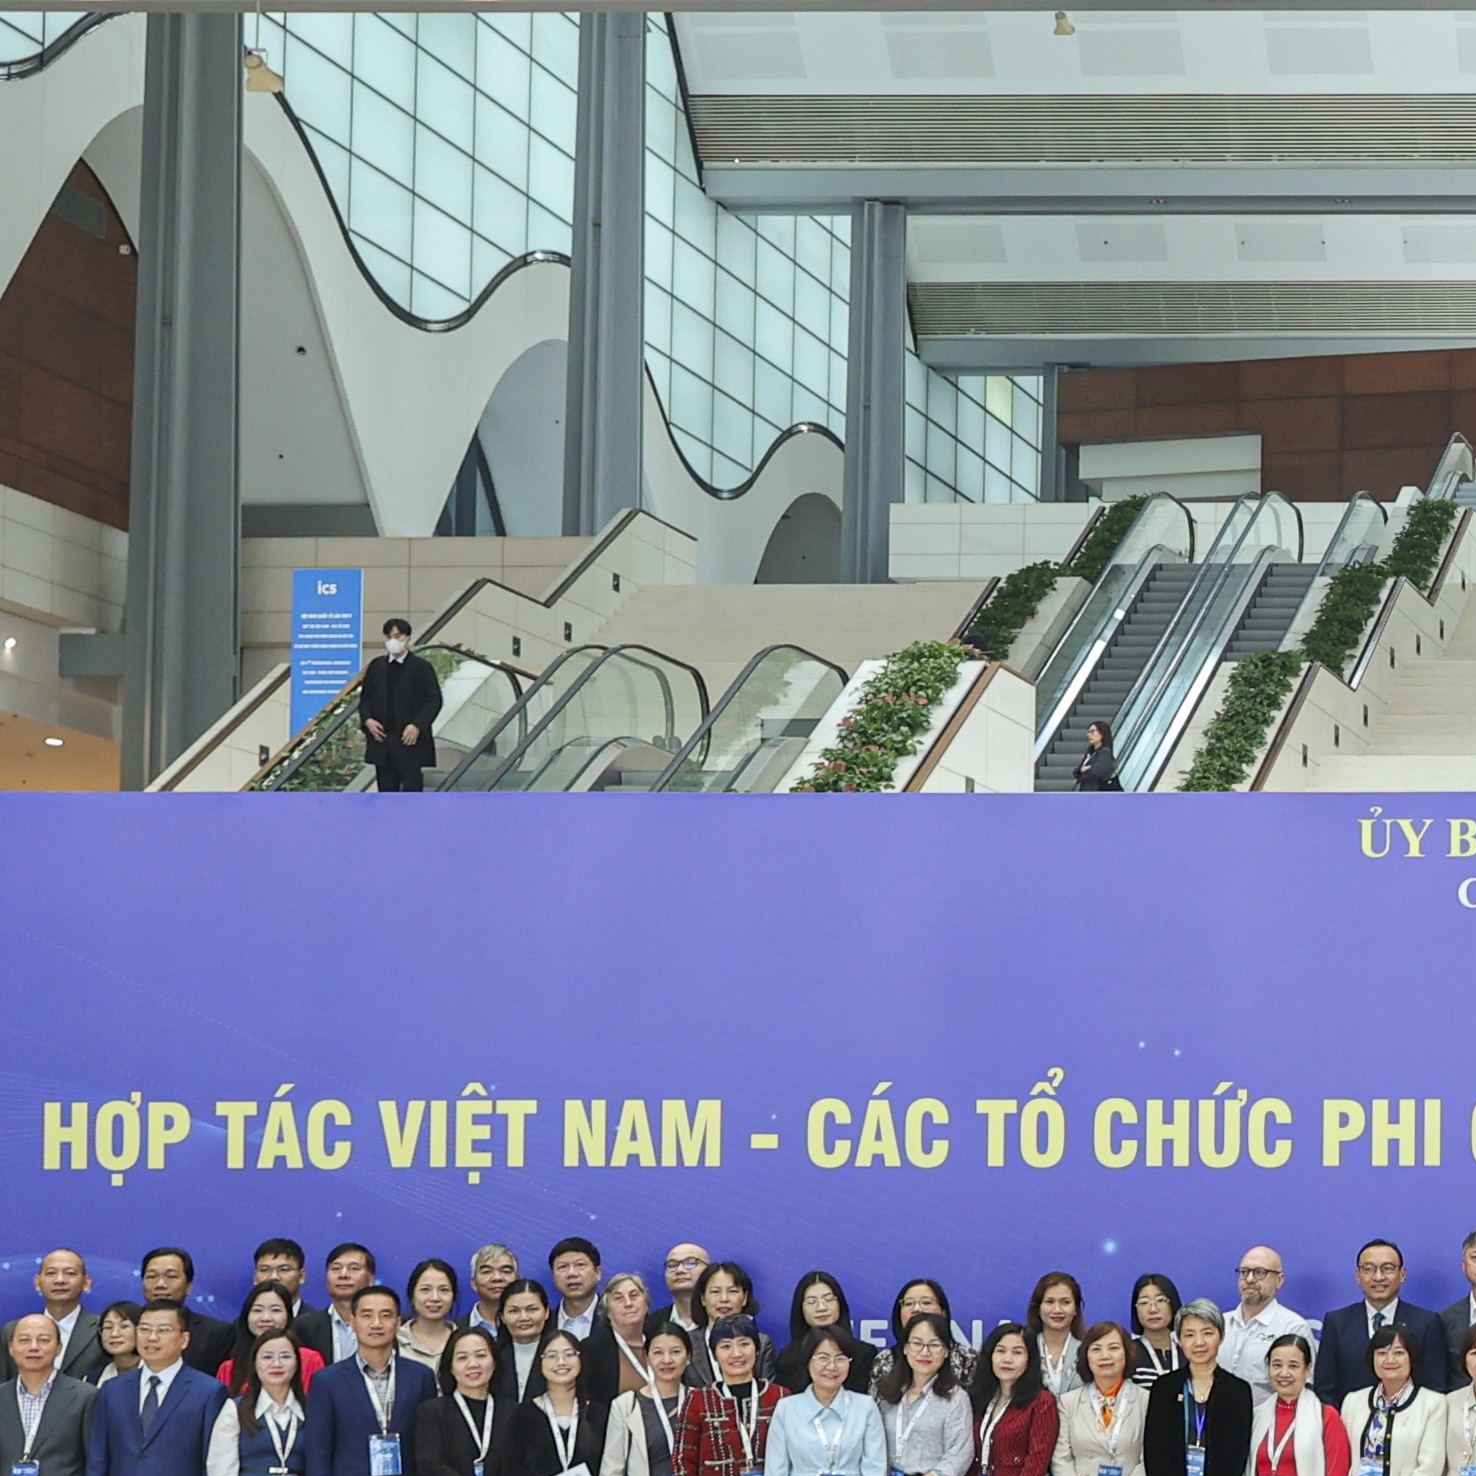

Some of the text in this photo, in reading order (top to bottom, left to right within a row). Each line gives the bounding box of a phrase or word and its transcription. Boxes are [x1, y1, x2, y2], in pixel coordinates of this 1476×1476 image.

[1359, 807, 1433, 857] ỦY
[45, 1093, 190, 1185] HỢP
[217, 1084, 351, 1169] TÁC
[381, 1083, 537, 1183] VIỆT
[565, 1100, 721, 1167] NAM
[752, 1135, 778, 1149] -
[808, 1083, 949, 1168] CÁC
[977, 1068, 1065, 1168] TỔ
[1095, 1083, 1292, 1168] CHỨC
[1324, 1100, 1441, 1167] PHI
